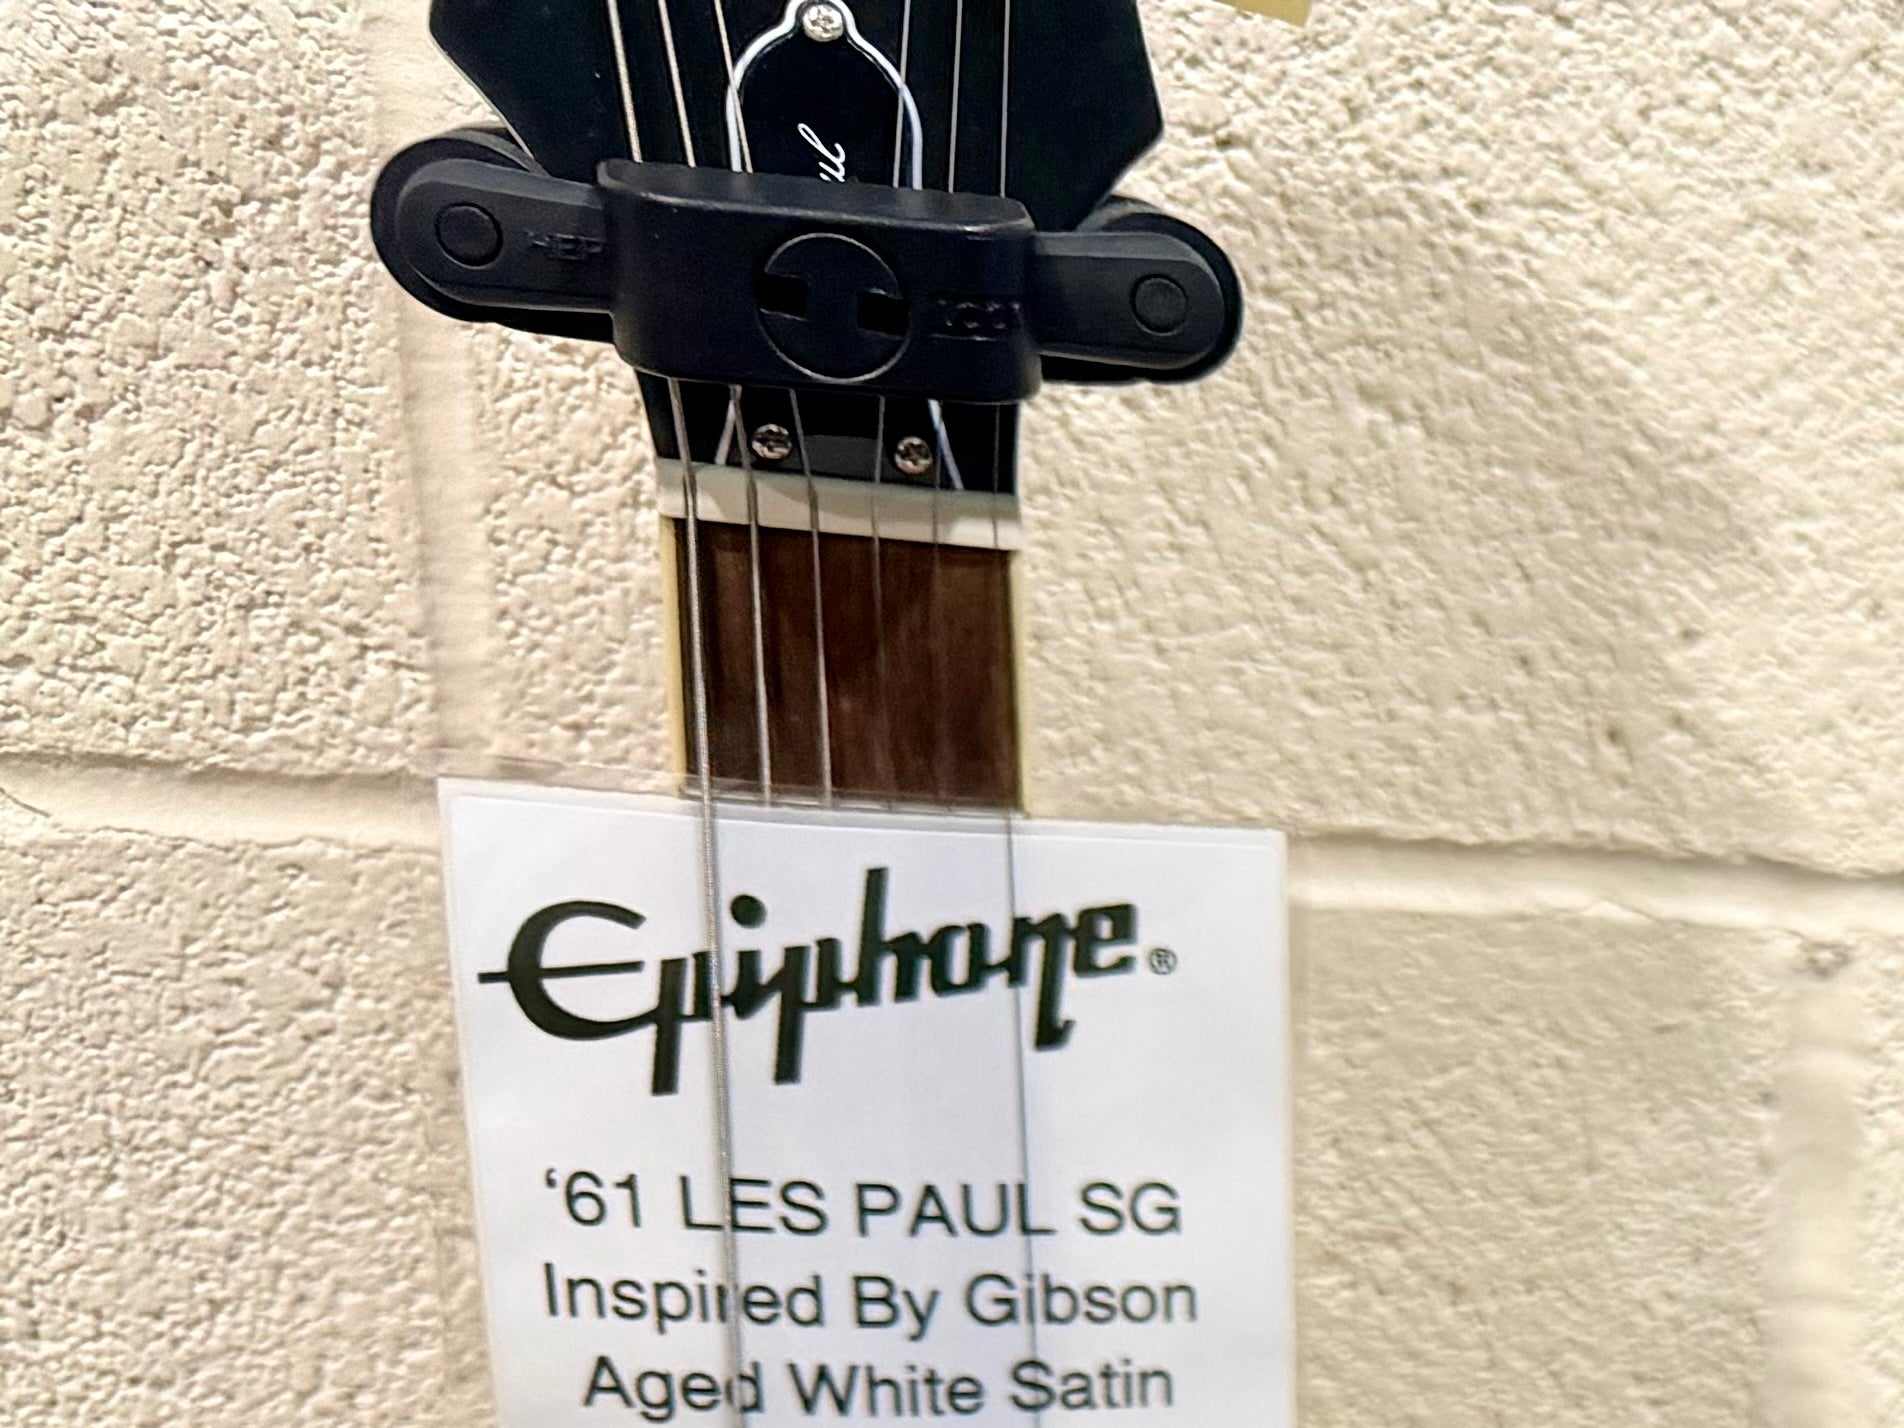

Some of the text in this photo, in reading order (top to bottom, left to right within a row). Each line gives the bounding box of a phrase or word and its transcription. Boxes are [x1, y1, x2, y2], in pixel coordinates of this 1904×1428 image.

[679, 1177, 827, 1234] LES
[855, 1180, 1057, 1239] PAUL
[1078, 1181, 1183, 1237] SG
[545, 1264, 1199, 1342] Inspired By Gibson
[584, 1357, 1175, 1423] Aged White Satin
